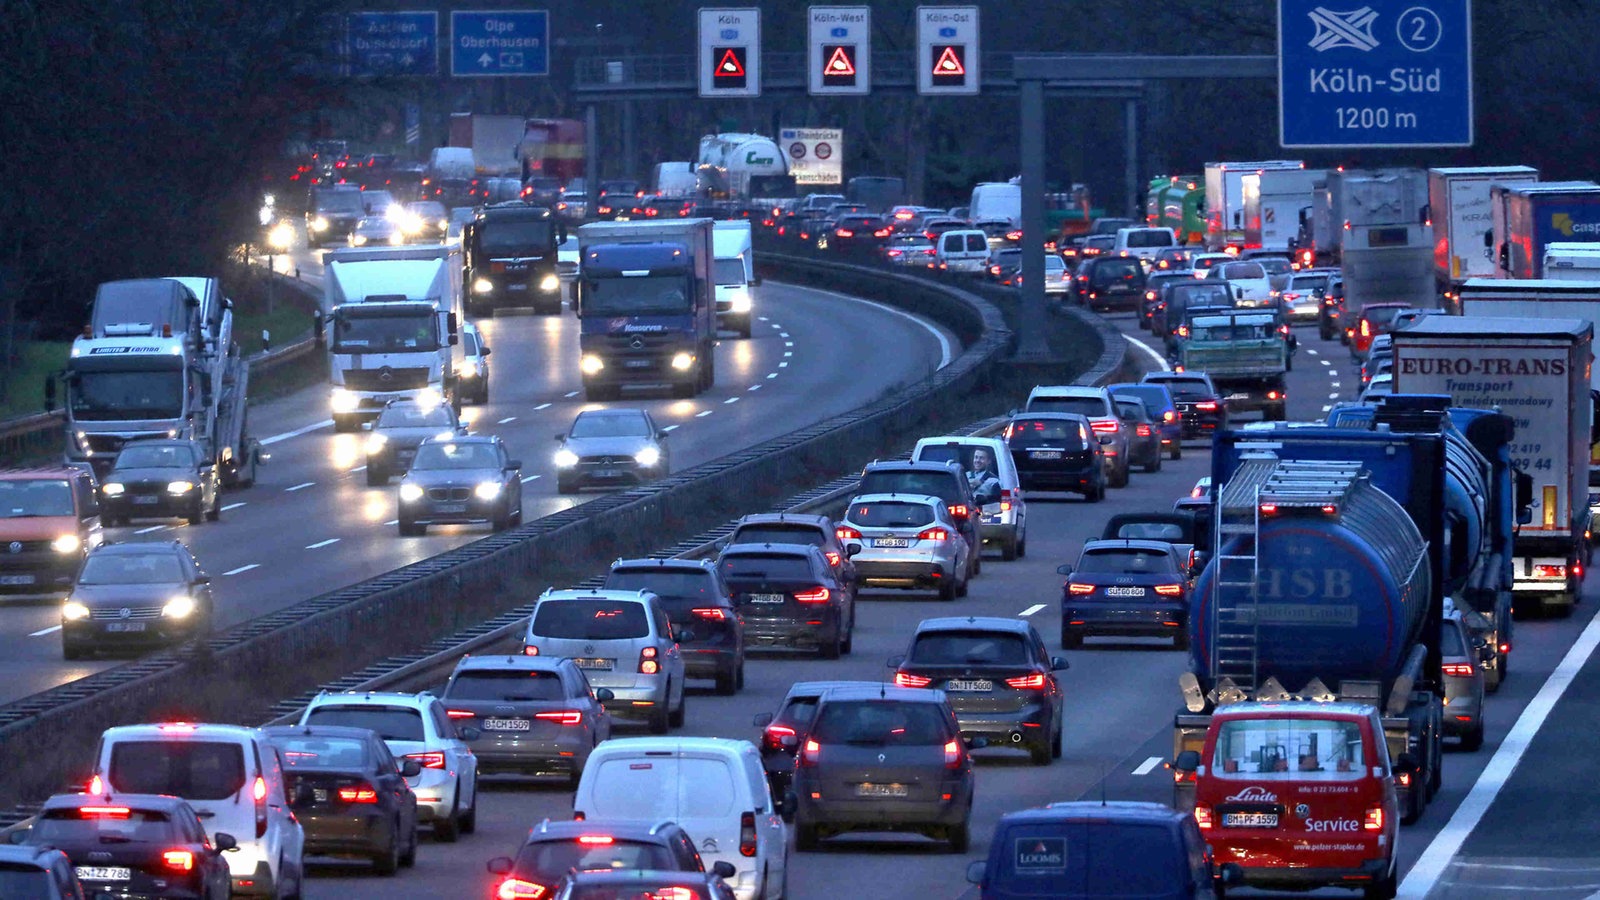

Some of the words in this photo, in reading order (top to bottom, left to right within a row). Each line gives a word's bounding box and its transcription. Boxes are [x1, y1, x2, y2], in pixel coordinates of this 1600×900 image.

[718, 15, 741, 25] Köln
[813, 13, 865, 23] Köln-West
[926, 13, 970, 23] Köln-Ost
[485, 20, 515, 34] Olpe
[1411, 17, 1426, 41] 2
[461, 36, 540, 48] Oberhausen
[1310, 67, 1441, 93] Köln-Süd
[1336, 107, 1389, 129] 1200
[1395, 112, 1417, 129] m
[797, 130, 839, 140] Rheinbrücke
[1401, 358, 1565, 376] EURO-TRANS
[1445, 379, 1514, 394] Transport
[1534, 458, 1552, 471] 44
[1246, 568, 1353, 598] HSB
[1225, 786, 1278, 802] Linde
[1227, 814, 1239, 824] BM
[1244, 814, 1254, 824] PF
[1256, 814, 1277, 824] 1559
[1305, 818, 1359, 832] Service
[1020, 853, 1061, 864] LOOMIS
[111, 867, 130, 879] 786
